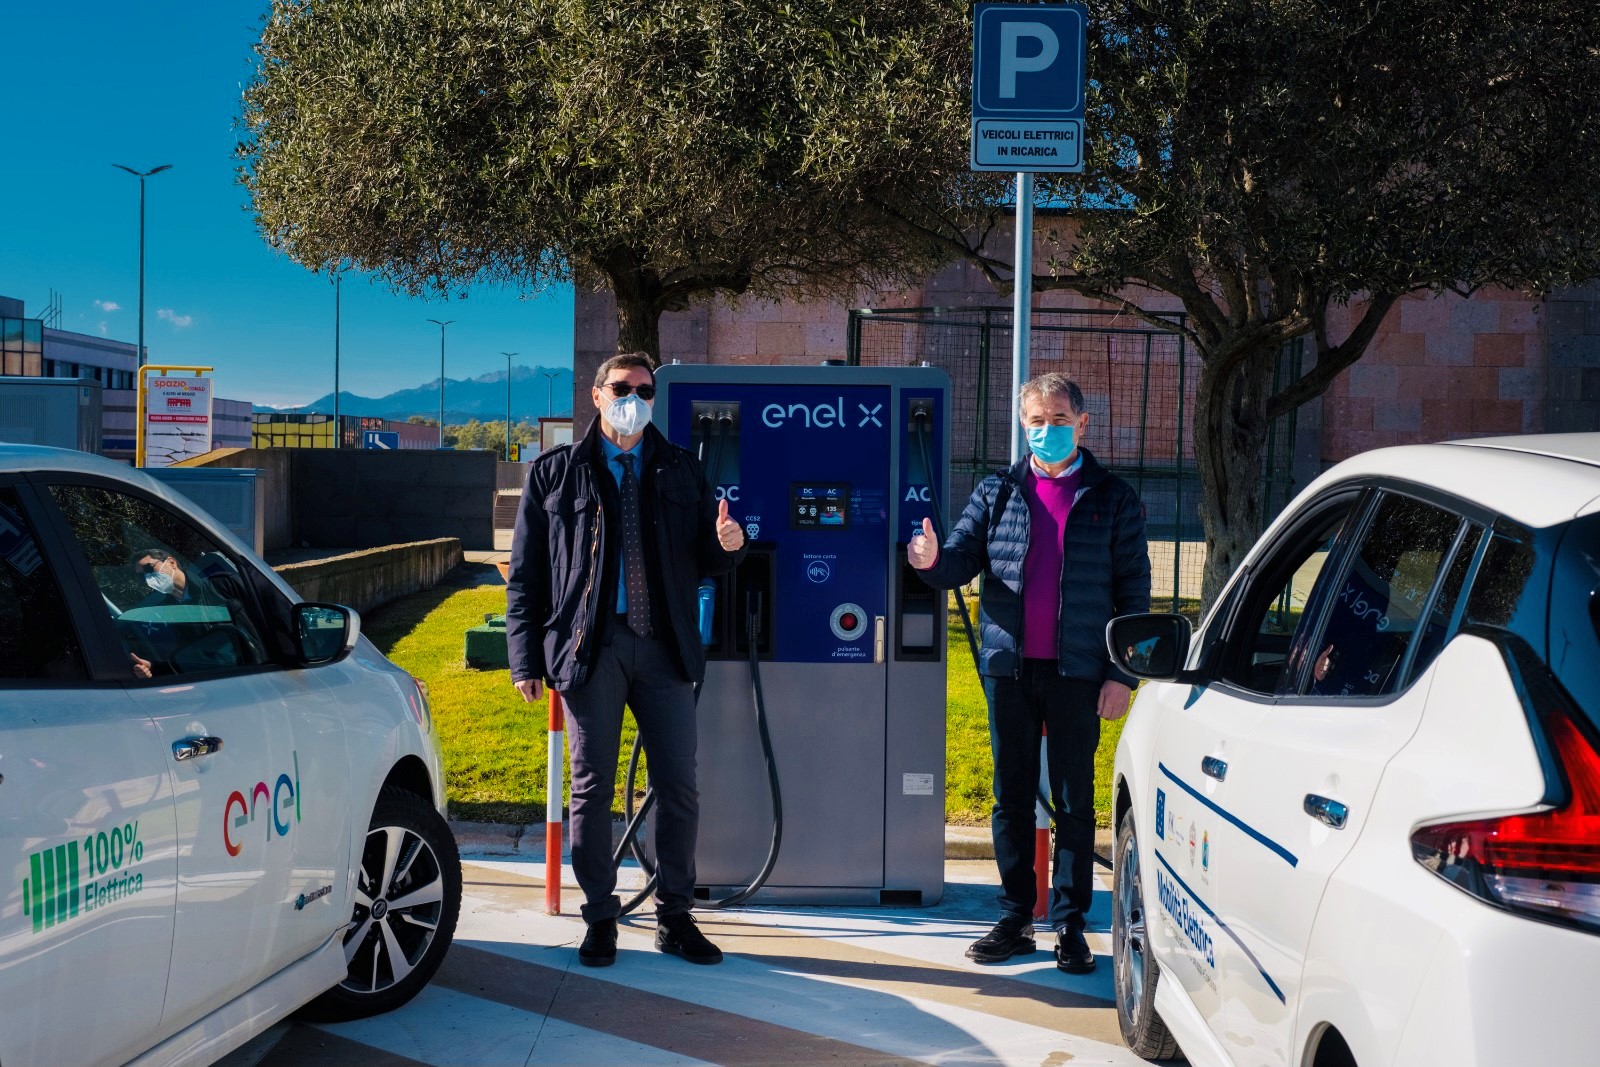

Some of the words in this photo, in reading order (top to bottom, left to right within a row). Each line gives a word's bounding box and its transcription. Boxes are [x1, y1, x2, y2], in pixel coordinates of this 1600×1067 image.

[998, 21, 1060, 98] P
[982, 130, 1021, 140] VEICOLI
[1023, 130, 1074, 141] ELETTRICI
[997, 147, 1008, 156] IN
[1011, 147, 1058, 157] RICARICA
[154, 380, 187, 389] spazio
[761, 396, 846, 428] enel
[904, 486, 931, 502] AC
[831, 651, 867, 659] d'emergenza
[223, 750, 301, 857] enel
[83, 820, 144, 879] 100%
[84, 870, 143, 913] Elettrica
[1181, 897, 1215, 970] Elettrica
